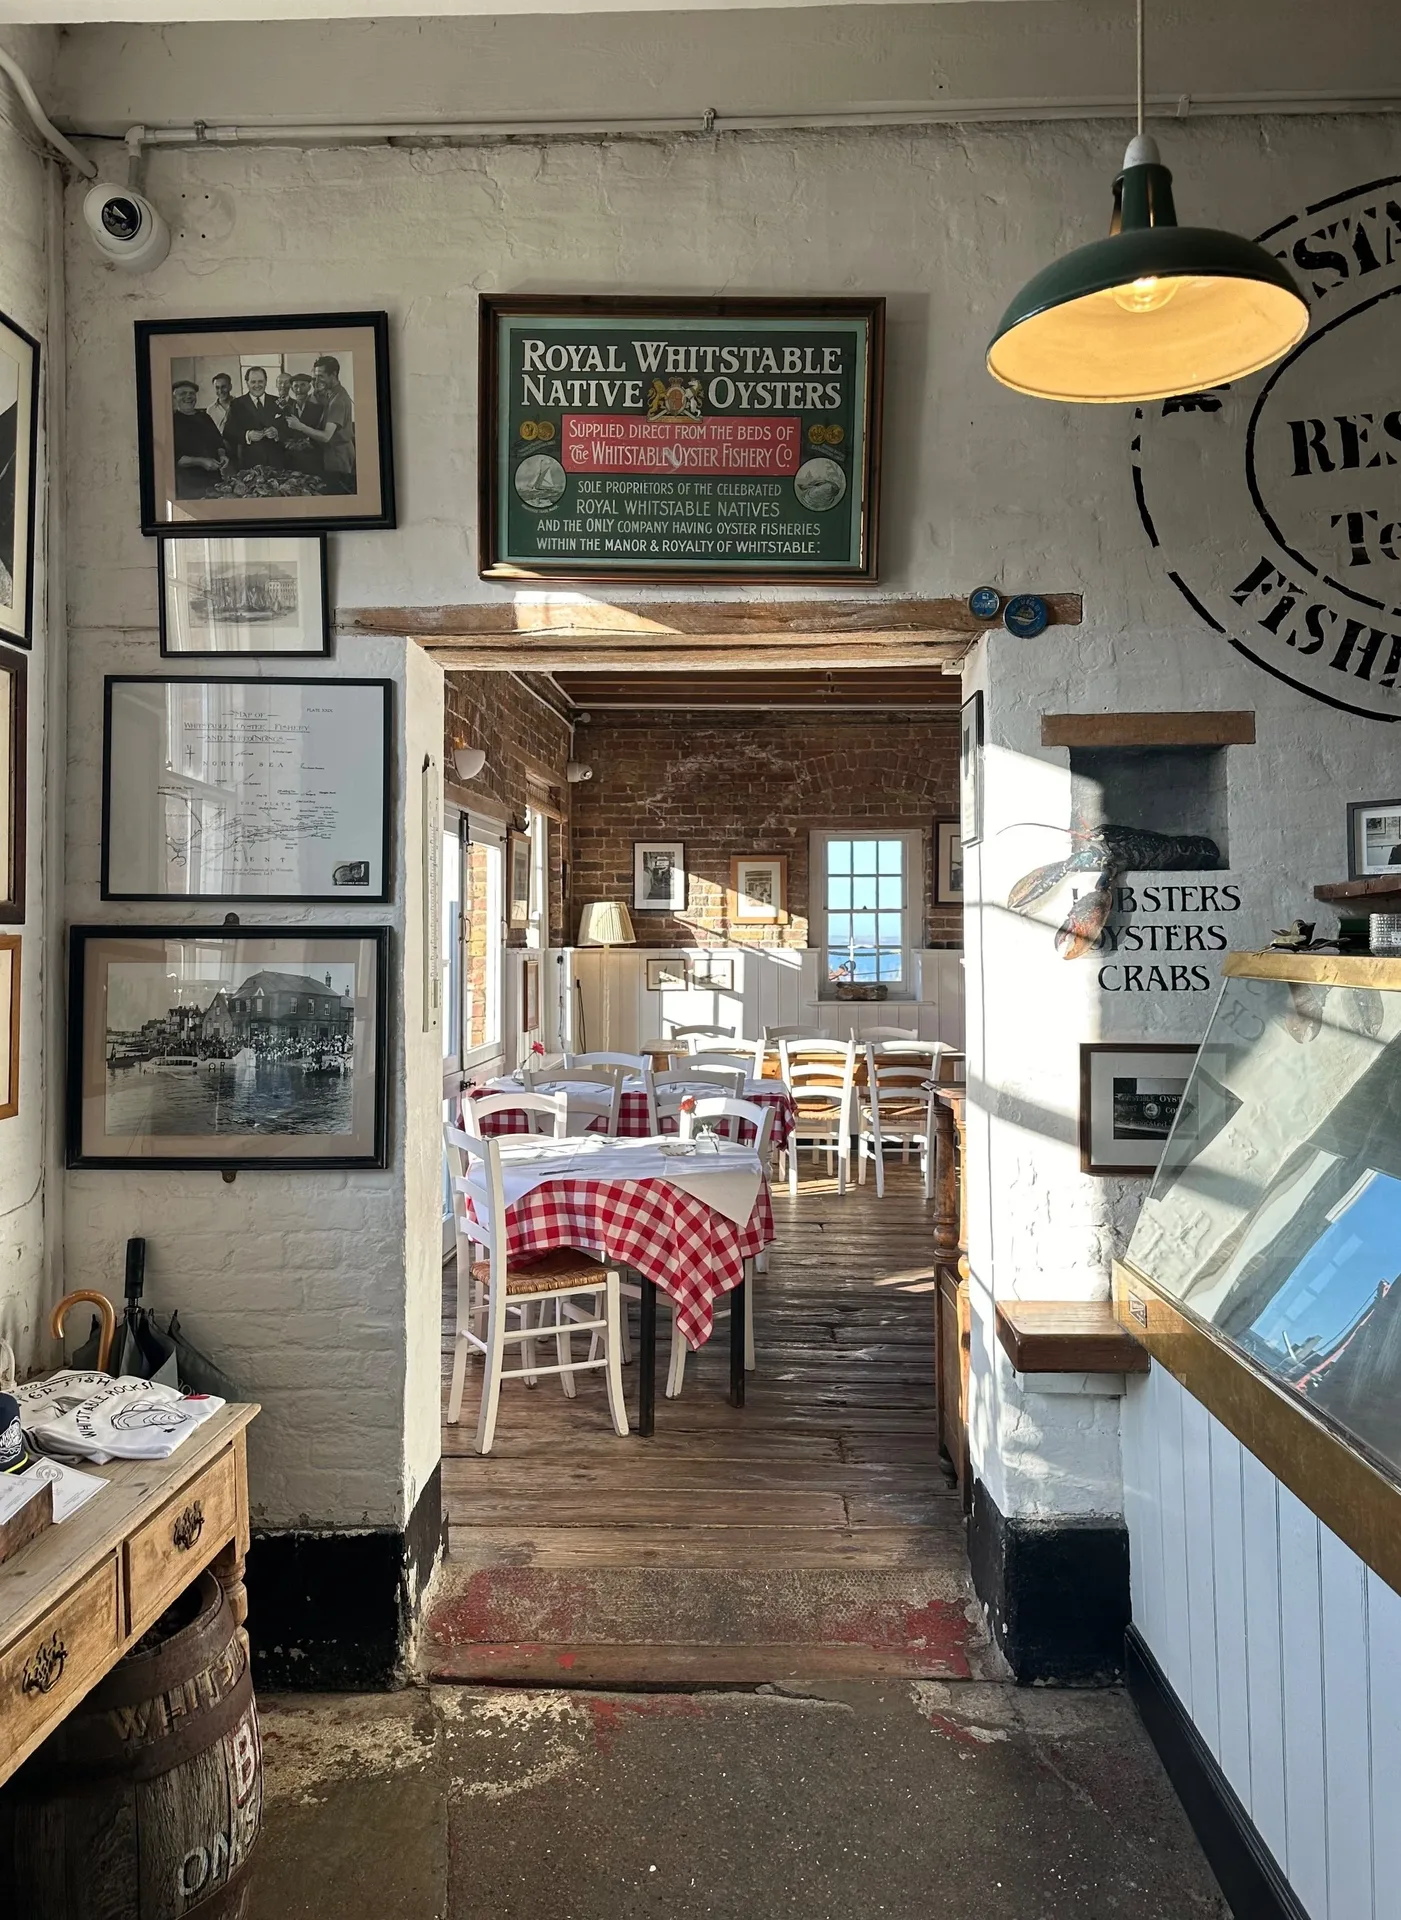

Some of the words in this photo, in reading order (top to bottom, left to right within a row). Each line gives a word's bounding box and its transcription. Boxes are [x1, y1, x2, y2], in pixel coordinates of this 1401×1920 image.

[521, 339, 627, 372] ROYAL
[631, 341, 843, 375] WHITSTABLE
[521, 374, 643, 408] NATIVE
[708, 376, 842, 409] OYSTERS
[569, 419, 625, 438] SUPPLIED
[629, 424, 672, 439] DIRECT
[675, 425, 707, 440] FROM
[710, 426, 734, 440] THE
[738, 426, 771, 440] BEDS
[776, 426, 794, 440] OF
[569, 444, 589, 465] The
[591, 441, 669, 466] WHITSTABLE
[672, 443, 719, 467] OYSTER
[722, 443, 773, 468] FISHERY
[578, 480, 602, 493] SOLE
[606, 481, 674, 495] PROPRIETORS
[678, 482, 691, 495] OF
[694, 483, 713, 496] THE
[717, 483, 782, 497] CELEBRATED
[576, 498, 619, 515] ROYAL
[624, 500, 711, 517] WHITSTABLE
[717, 501, 780, 518] NATIVES
[537, 519, 560, 532] AND
[563, 519, 583, 532] THE
[586, 518, 615, 533] ONLY
[617, 520, 669, 533] COMPANY
[672, 521, 713, 534] HAVING
[716, 522, 757, 535] OYSTER
[761, 522, 821, 536] FISHERIES
[536, 537, 576, 551] WITHIN
[580, 538, 601, 551] THE
[605, 539, 647, 552] MANOR
[649, 539, 659, 552] &
[662, 539, 715, 553] ROYALTY
[716, 540, 733, 553] OF
[1072, 885, 1241, 913] BSTERS
[1098, 964, 1210, 992] CRABS
